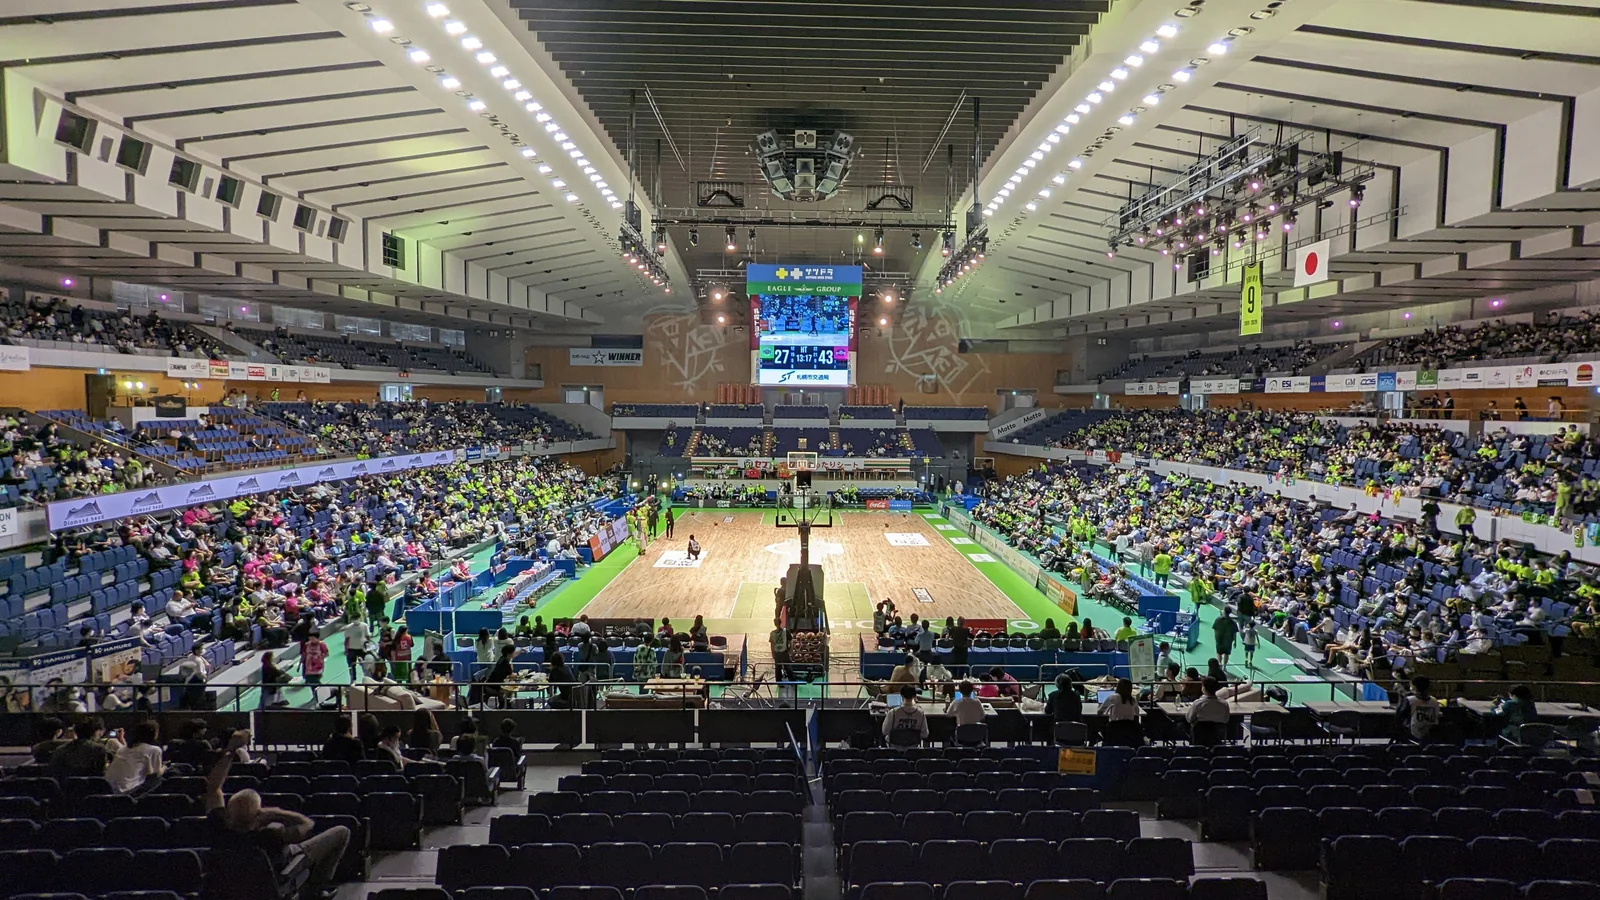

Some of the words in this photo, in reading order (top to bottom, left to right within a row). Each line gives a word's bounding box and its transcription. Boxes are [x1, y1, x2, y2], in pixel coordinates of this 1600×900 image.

[805, 268, 833, 276] サツドラ
[1247, 286, 1255, 313] 9
[608, 352, 641, 361] WINNER
[774, 349, 789, 364] 27
[796, 354, 812, 362] 13:17
[818, 350, 833, 364] 43
[1023, 411, 1041, 423] Motto
[997, 423, 1016, 434] Motto
[130, 506, 151, 514] Diamond
[64, 517, 89, 527] Diamond
[90, 514, 105, 522] head
[614, 625, 638, 633] SoftBan
